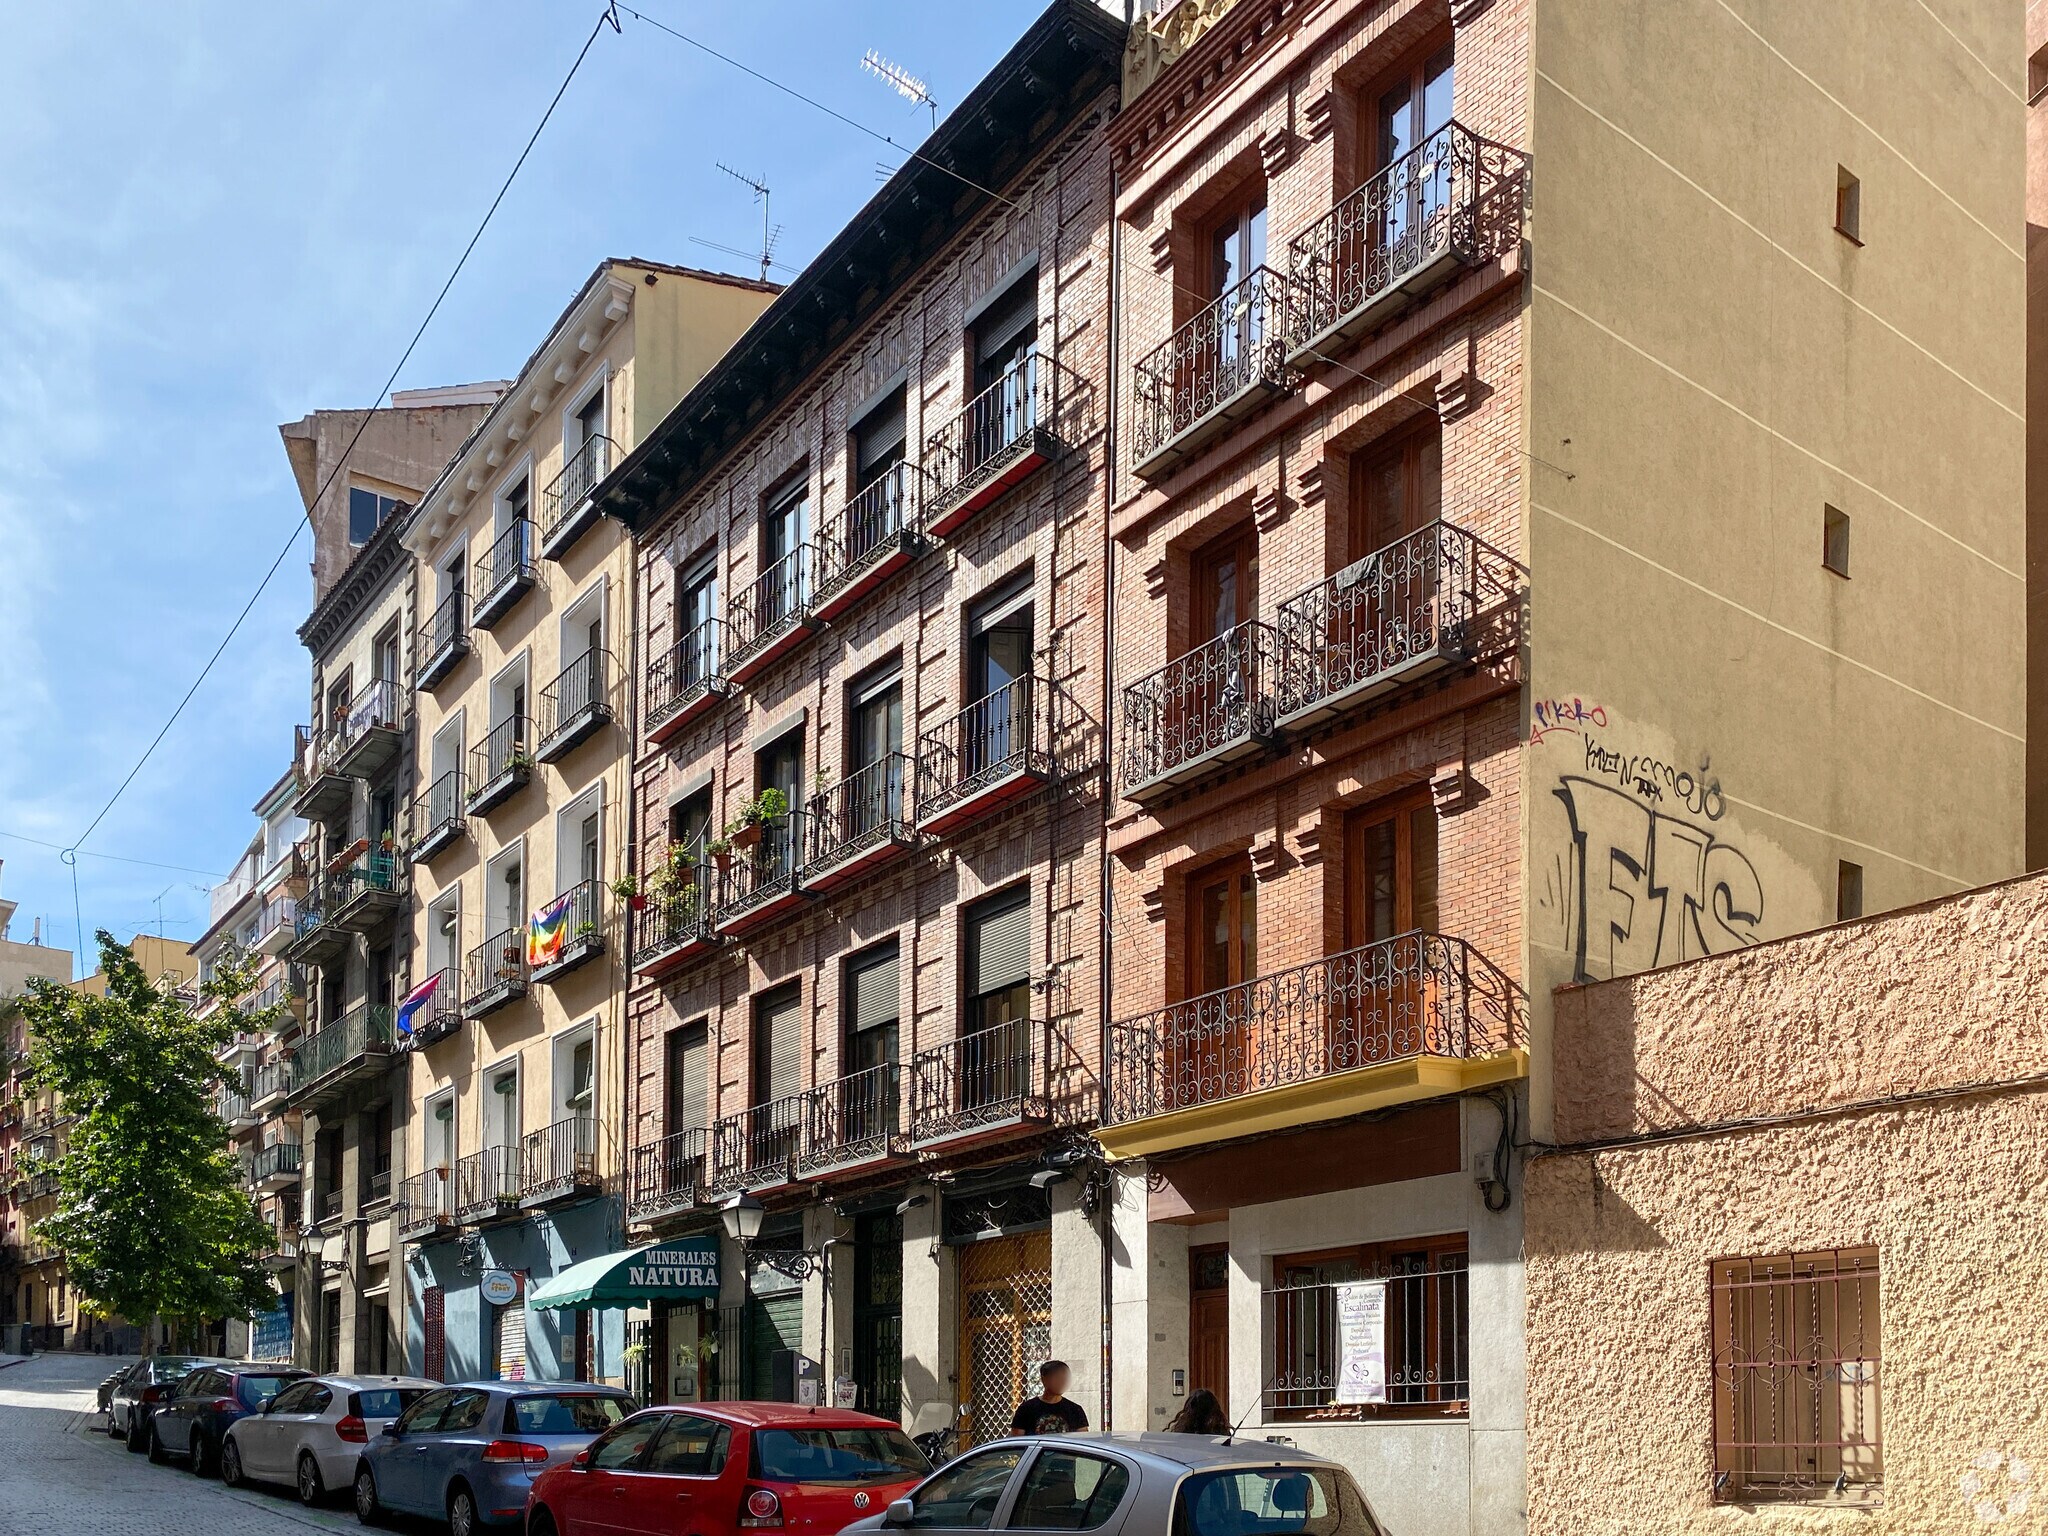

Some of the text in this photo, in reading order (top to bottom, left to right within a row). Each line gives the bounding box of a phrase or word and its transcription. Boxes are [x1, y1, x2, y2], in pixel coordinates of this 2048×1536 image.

[645, 1250, 717, 1266] MINERALES
[629, 1266, 719, 1286] NATURA
[1344, 1301, 1380, 1312] Escalinata
[798, 1359, 810, 1375] P
